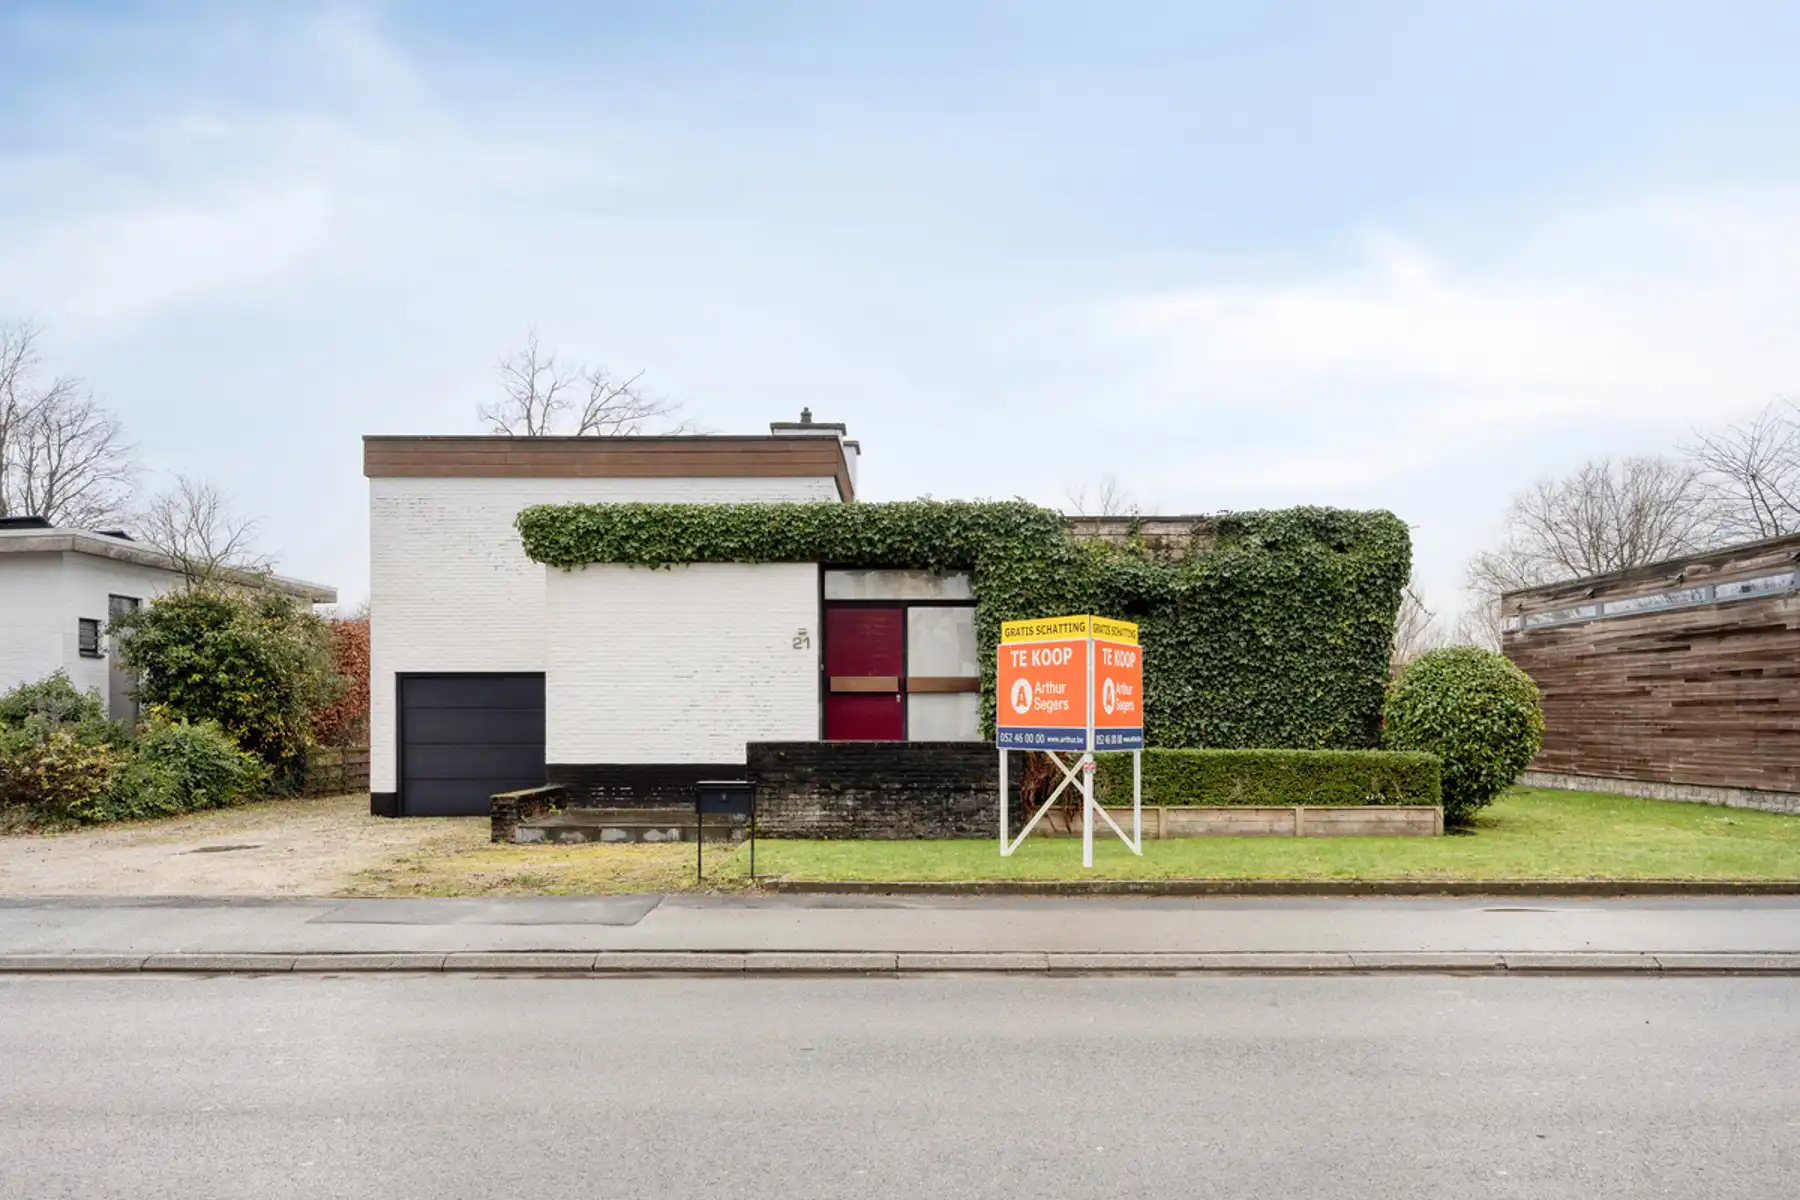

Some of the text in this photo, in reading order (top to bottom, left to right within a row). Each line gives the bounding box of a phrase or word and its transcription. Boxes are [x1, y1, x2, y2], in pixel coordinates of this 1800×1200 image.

[1004, 622, 1086, 638] GRATIS SCHATTING
[1093, 623, 1110, 635] GRATIS
[792, 636, 811, 650] 21
[1010, 648, 1073, 667] TE KOOP
[1102, 648, 1136, 668] TE KOOP
[1034, 681, 1066, 694] Arthur
[1034, 697, 1069, 713] Segers
[1000, 732, 1013, 743] 052
[1024, 732, 1034, 744] 00
[1035, 733, 1045, 744] 00
